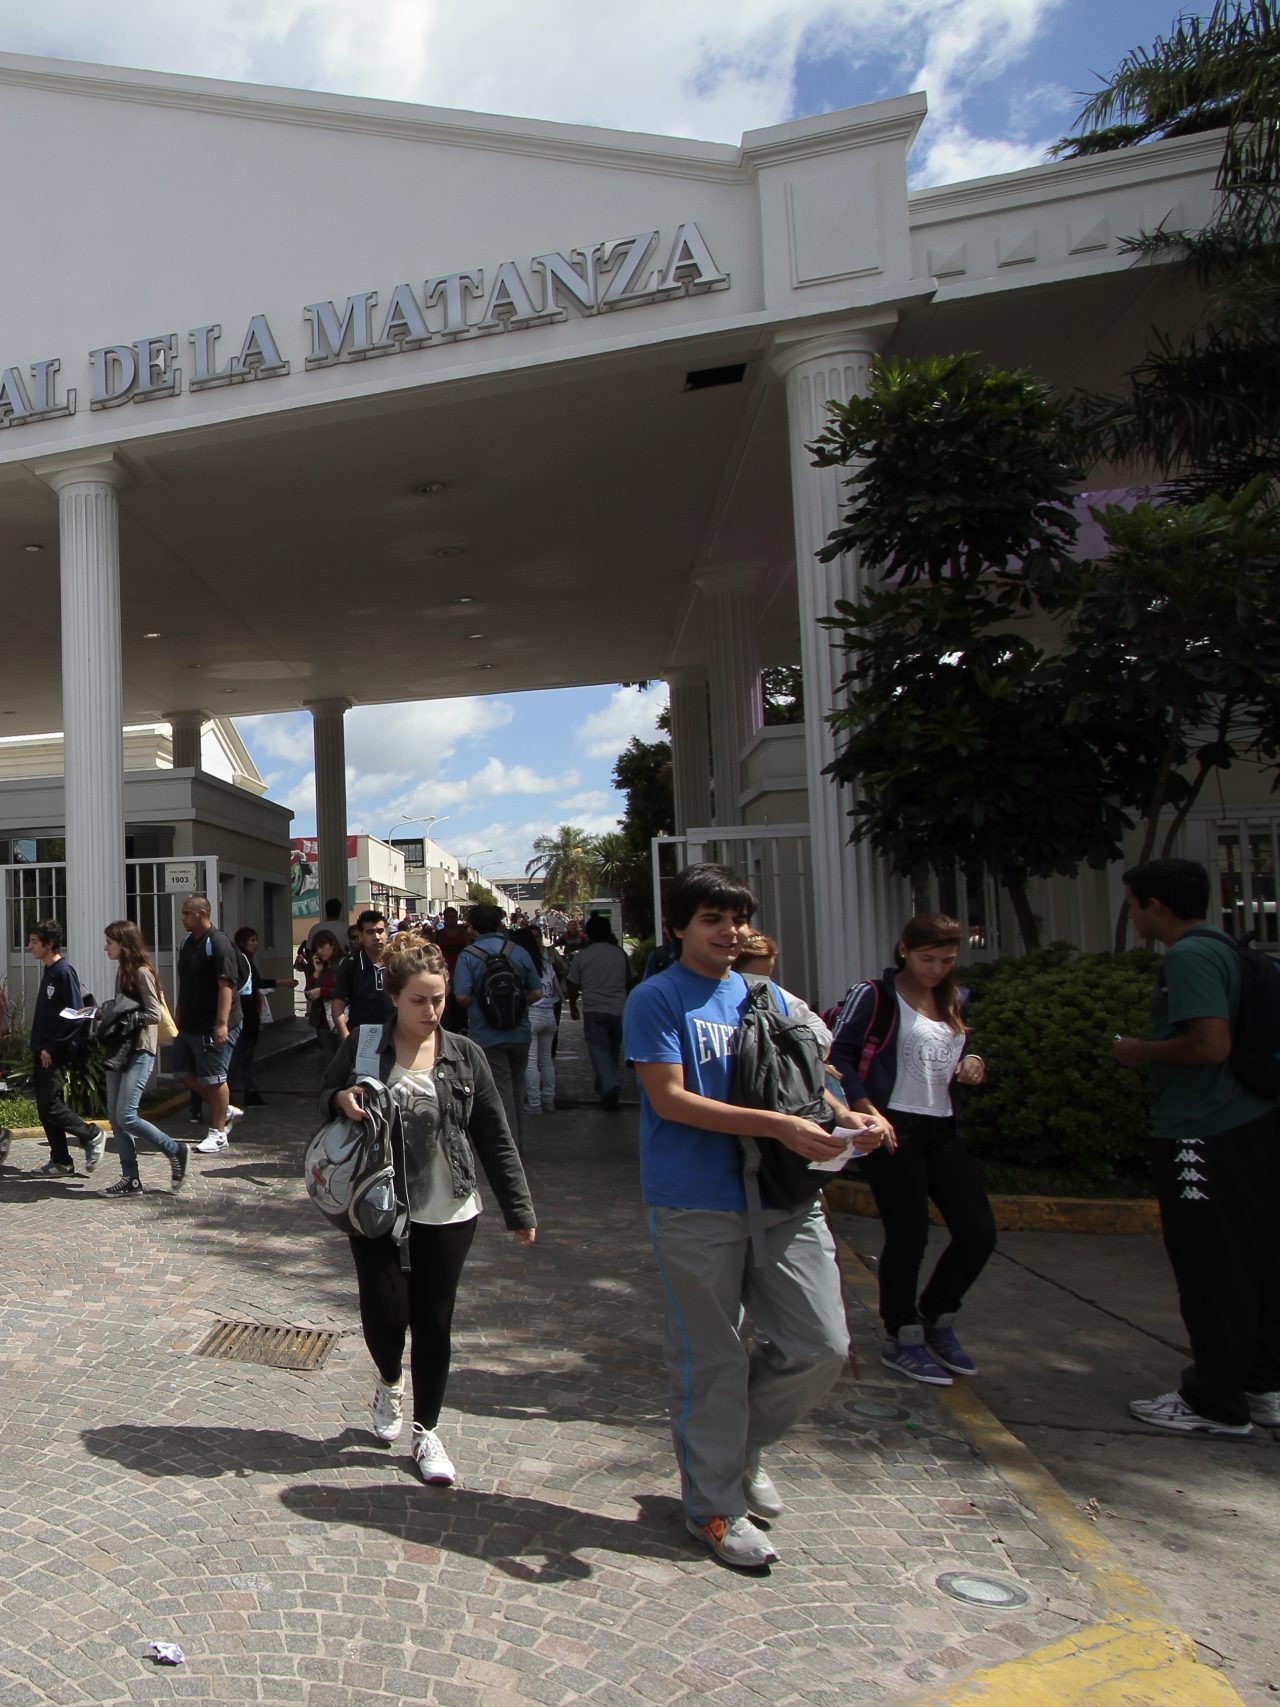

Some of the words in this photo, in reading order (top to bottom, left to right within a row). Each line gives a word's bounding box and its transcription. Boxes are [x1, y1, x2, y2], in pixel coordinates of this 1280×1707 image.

[89, 333, 182, 411] DE
[188, 314, 290, 392] LA
[303, 222, 731, 371] MATANZA
